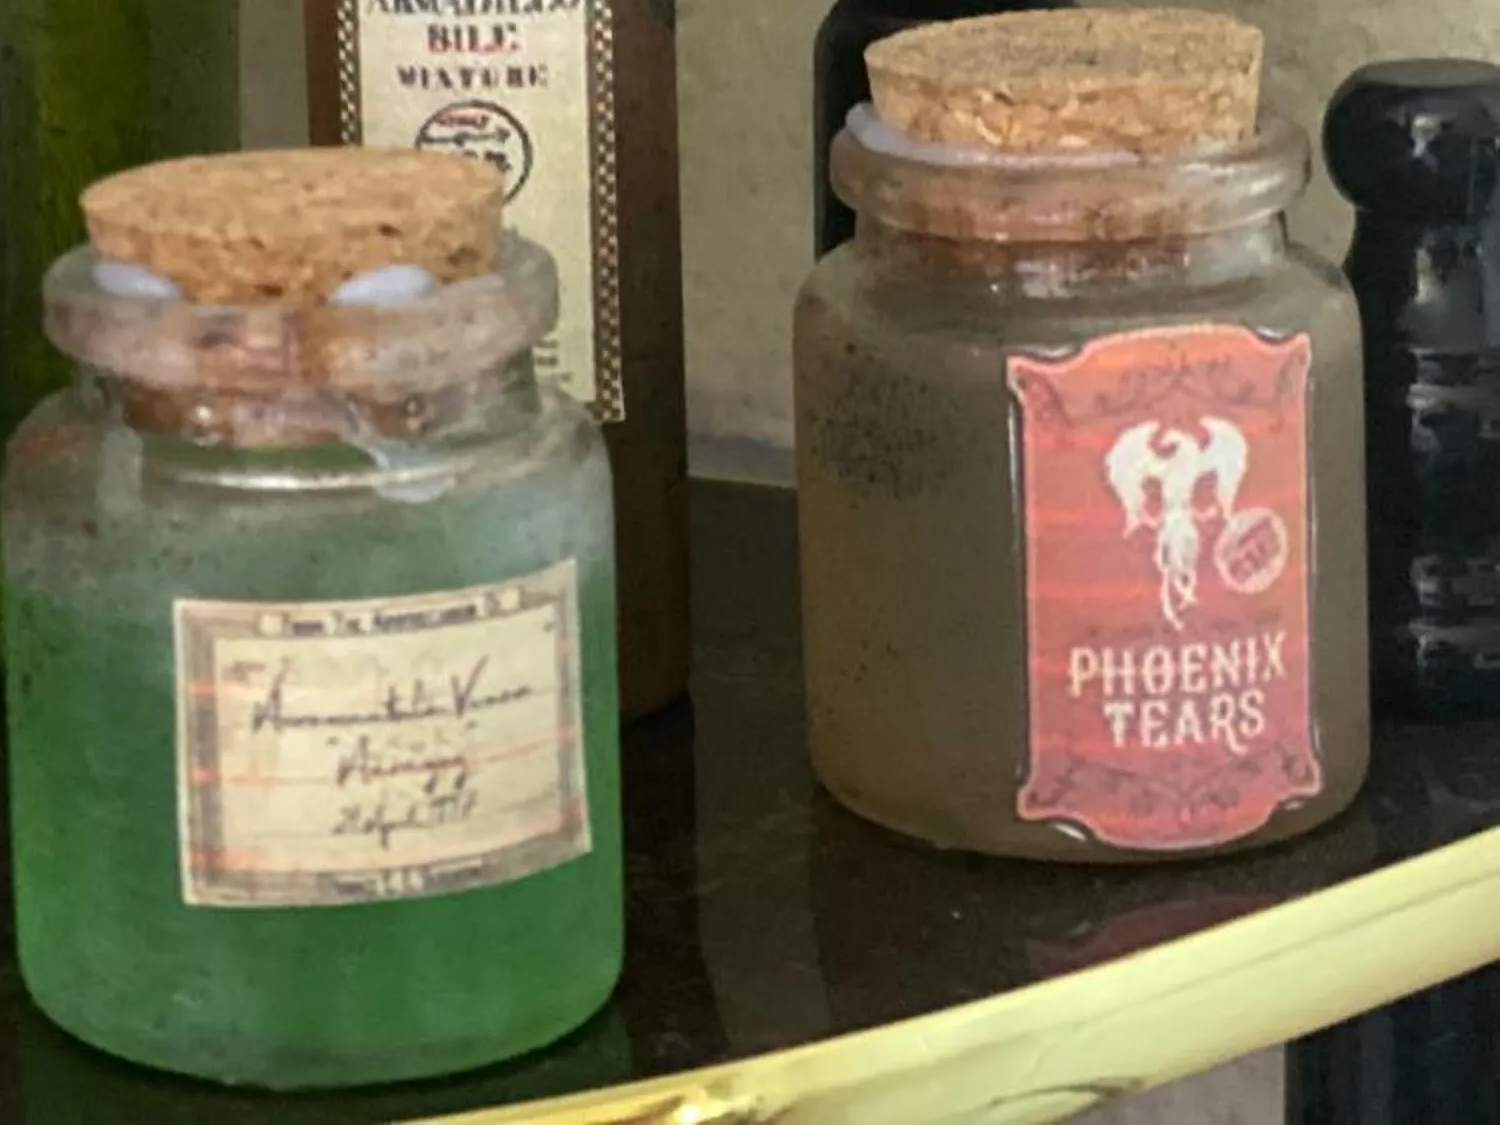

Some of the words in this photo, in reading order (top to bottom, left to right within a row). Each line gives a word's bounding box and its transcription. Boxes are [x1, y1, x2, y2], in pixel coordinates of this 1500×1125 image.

[426, 23, 520, 54] BILE
[396, 64, 549, 89] MIXTURE
[1067, 630, 1287, 699] PHOENIX
[1103, 688, 1265, 755] TEARS
